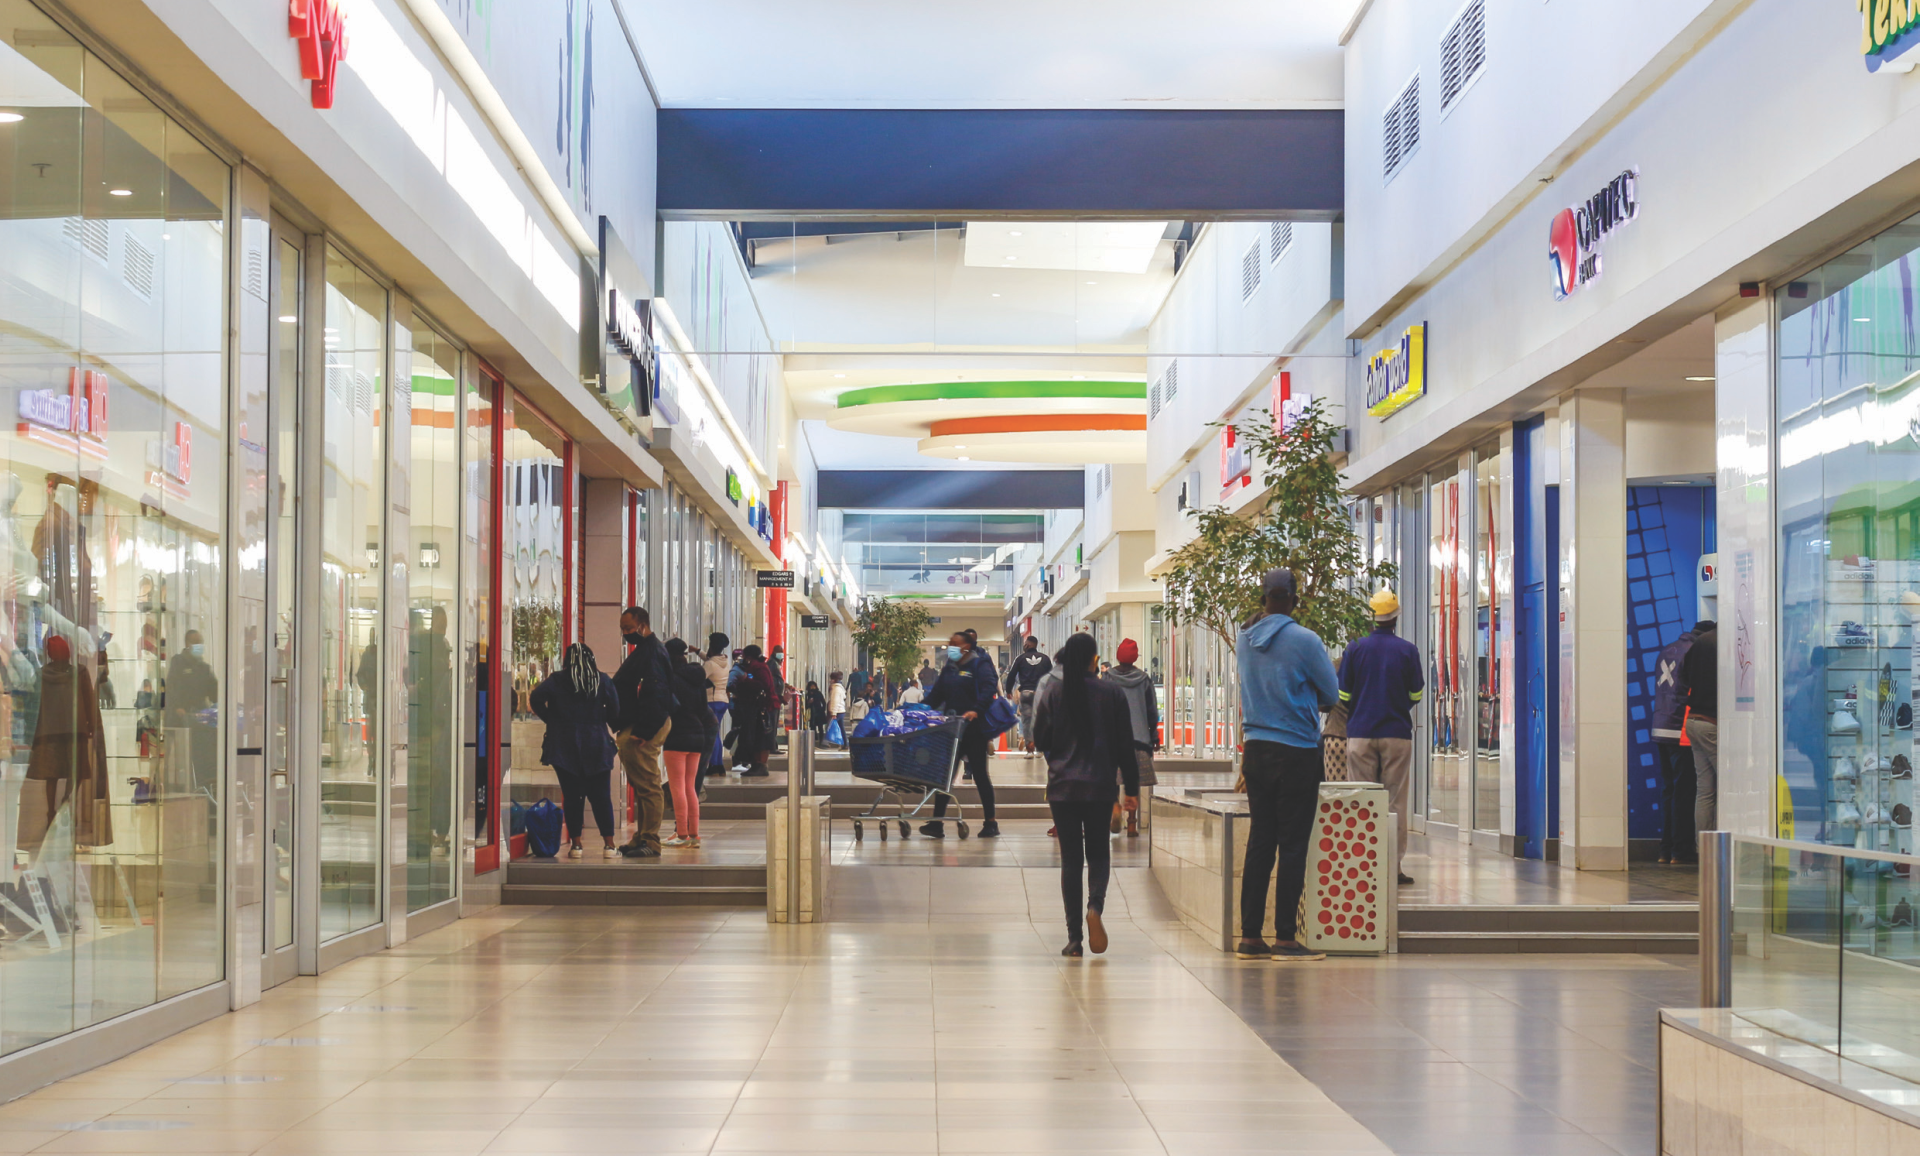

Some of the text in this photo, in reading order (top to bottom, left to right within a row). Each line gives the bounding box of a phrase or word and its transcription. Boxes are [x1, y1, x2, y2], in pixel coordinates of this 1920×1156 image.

[1576, 169, 1634, 252] CAPITEC
[1844, 572, 1875, 580] adidas
[1845, 637, 1876, 645] adidas
